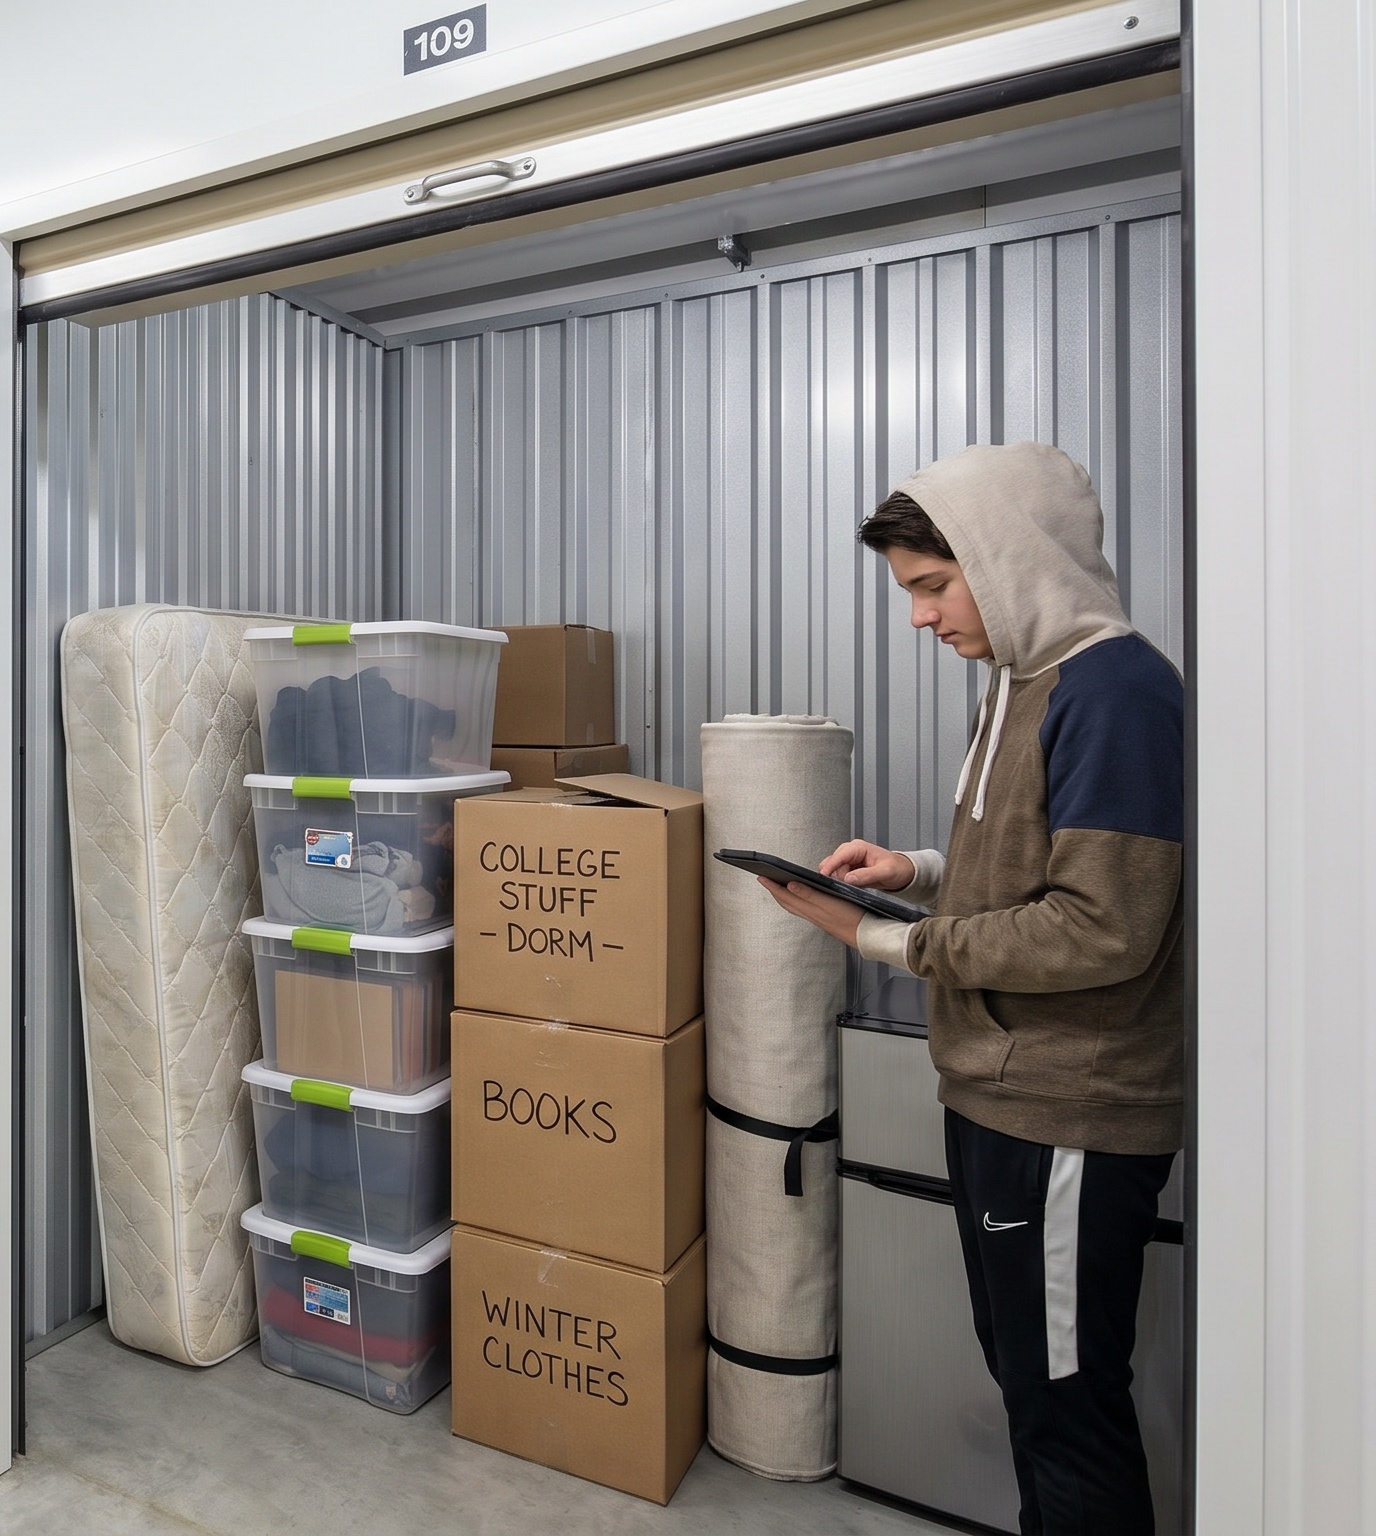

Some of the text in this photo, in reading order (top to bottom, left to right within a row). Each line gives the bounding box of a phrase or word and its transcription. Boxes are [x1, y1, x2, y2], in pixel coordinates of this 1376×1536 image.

[413, 18, 474, 61] 109
[479, 840, 621, 880] COLLEGE
[498, 880, 599, 918] STUFF
[506, 921, 595, 963] DORM
[482, 1078, 618, 1145] BOOKS
[480, 1289, 622, 1361] WINTER
[481, 1334, 630, 1408] CLOTHES
